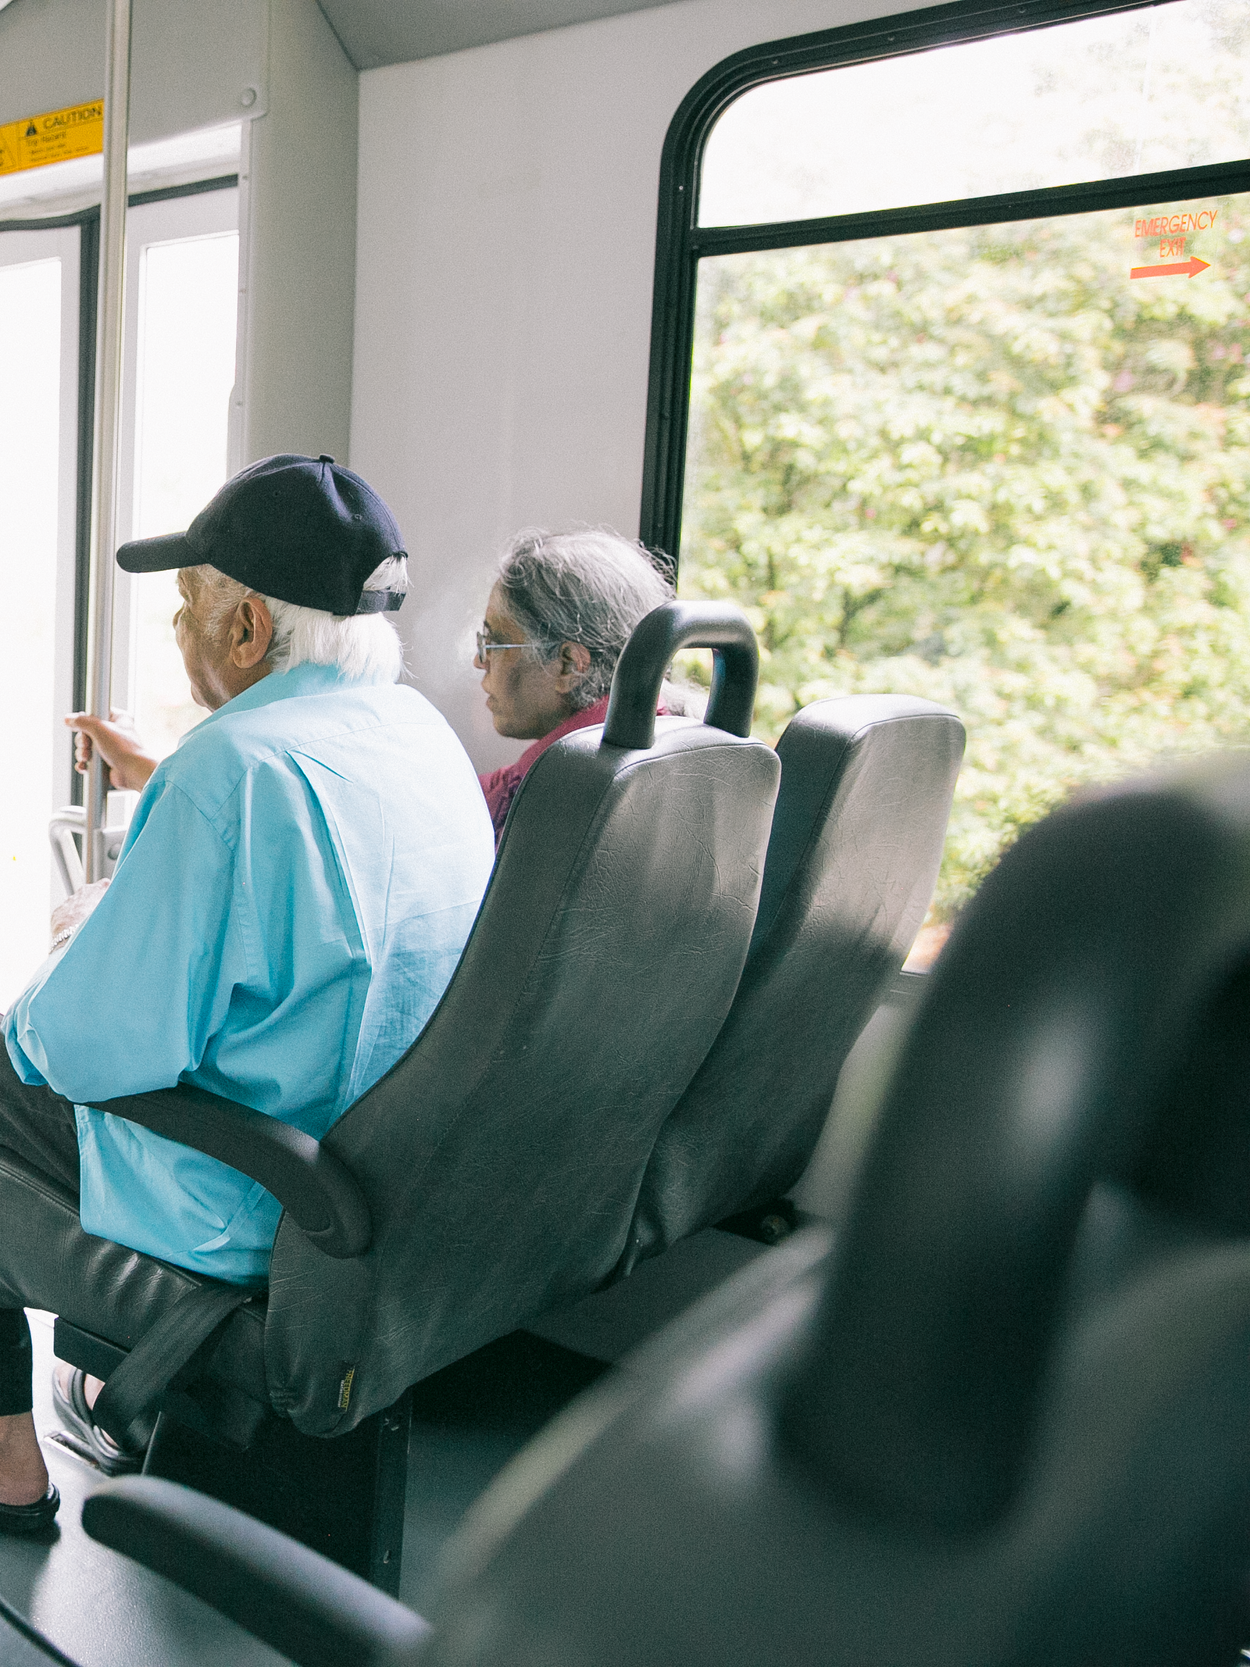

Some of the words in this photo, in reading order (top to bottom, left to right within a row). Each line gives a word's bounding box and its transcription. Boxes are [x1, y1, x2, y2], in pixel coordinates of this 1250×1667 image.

[43, 104, 102, 130] CAUTION
[1135, 210, 1218, 238] EMERGENCY
[1159, 237, 1186, 258] EXIT
